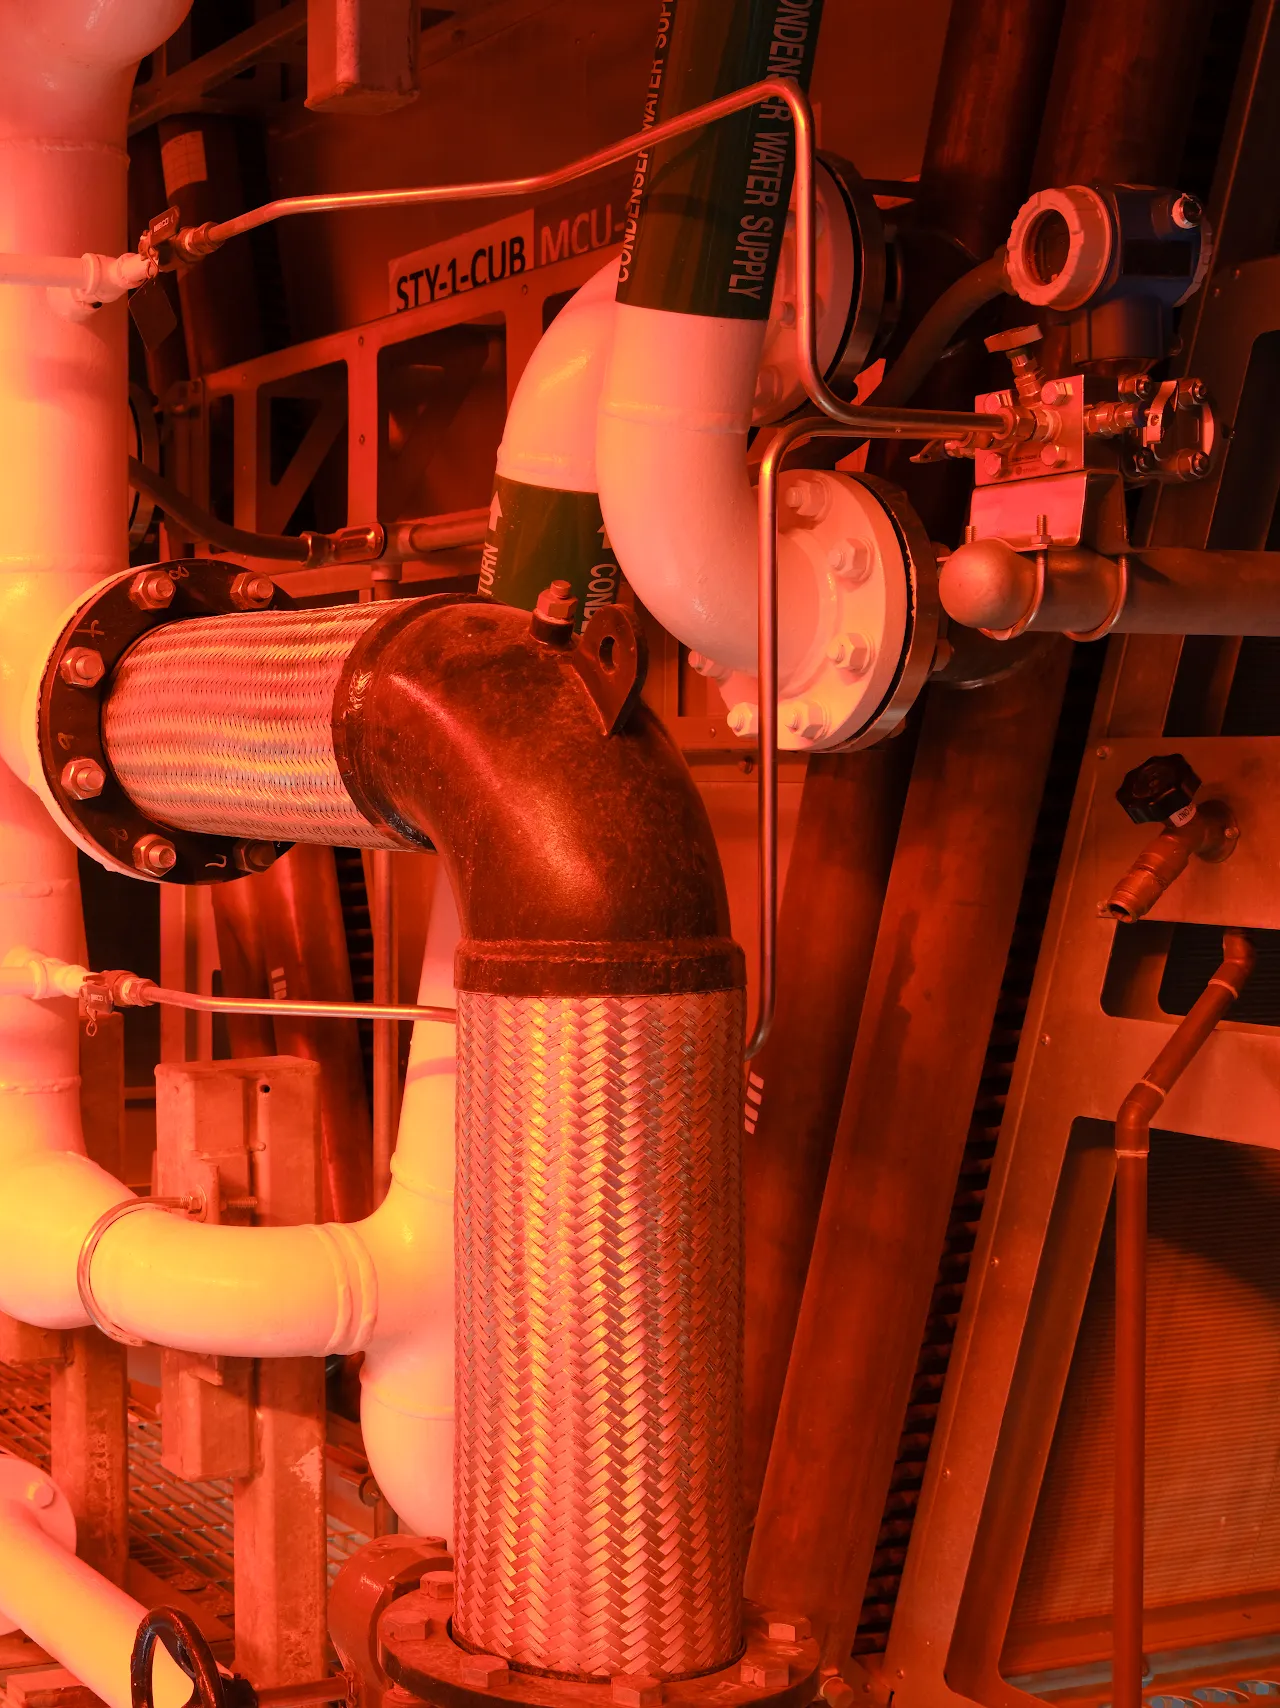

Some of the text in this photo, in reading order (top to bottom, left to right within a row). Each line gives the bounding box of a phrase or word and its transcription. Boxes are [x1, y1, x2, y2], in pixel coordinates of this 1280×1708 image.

[654, 0, 674, 49] SUP
[743, 131, 790, 207] WATER
[396, 236, 526, 313] STY-1-CUB
[728, 214, 774, 300] SUPPLY
[581, 563, 617, 636] CON
